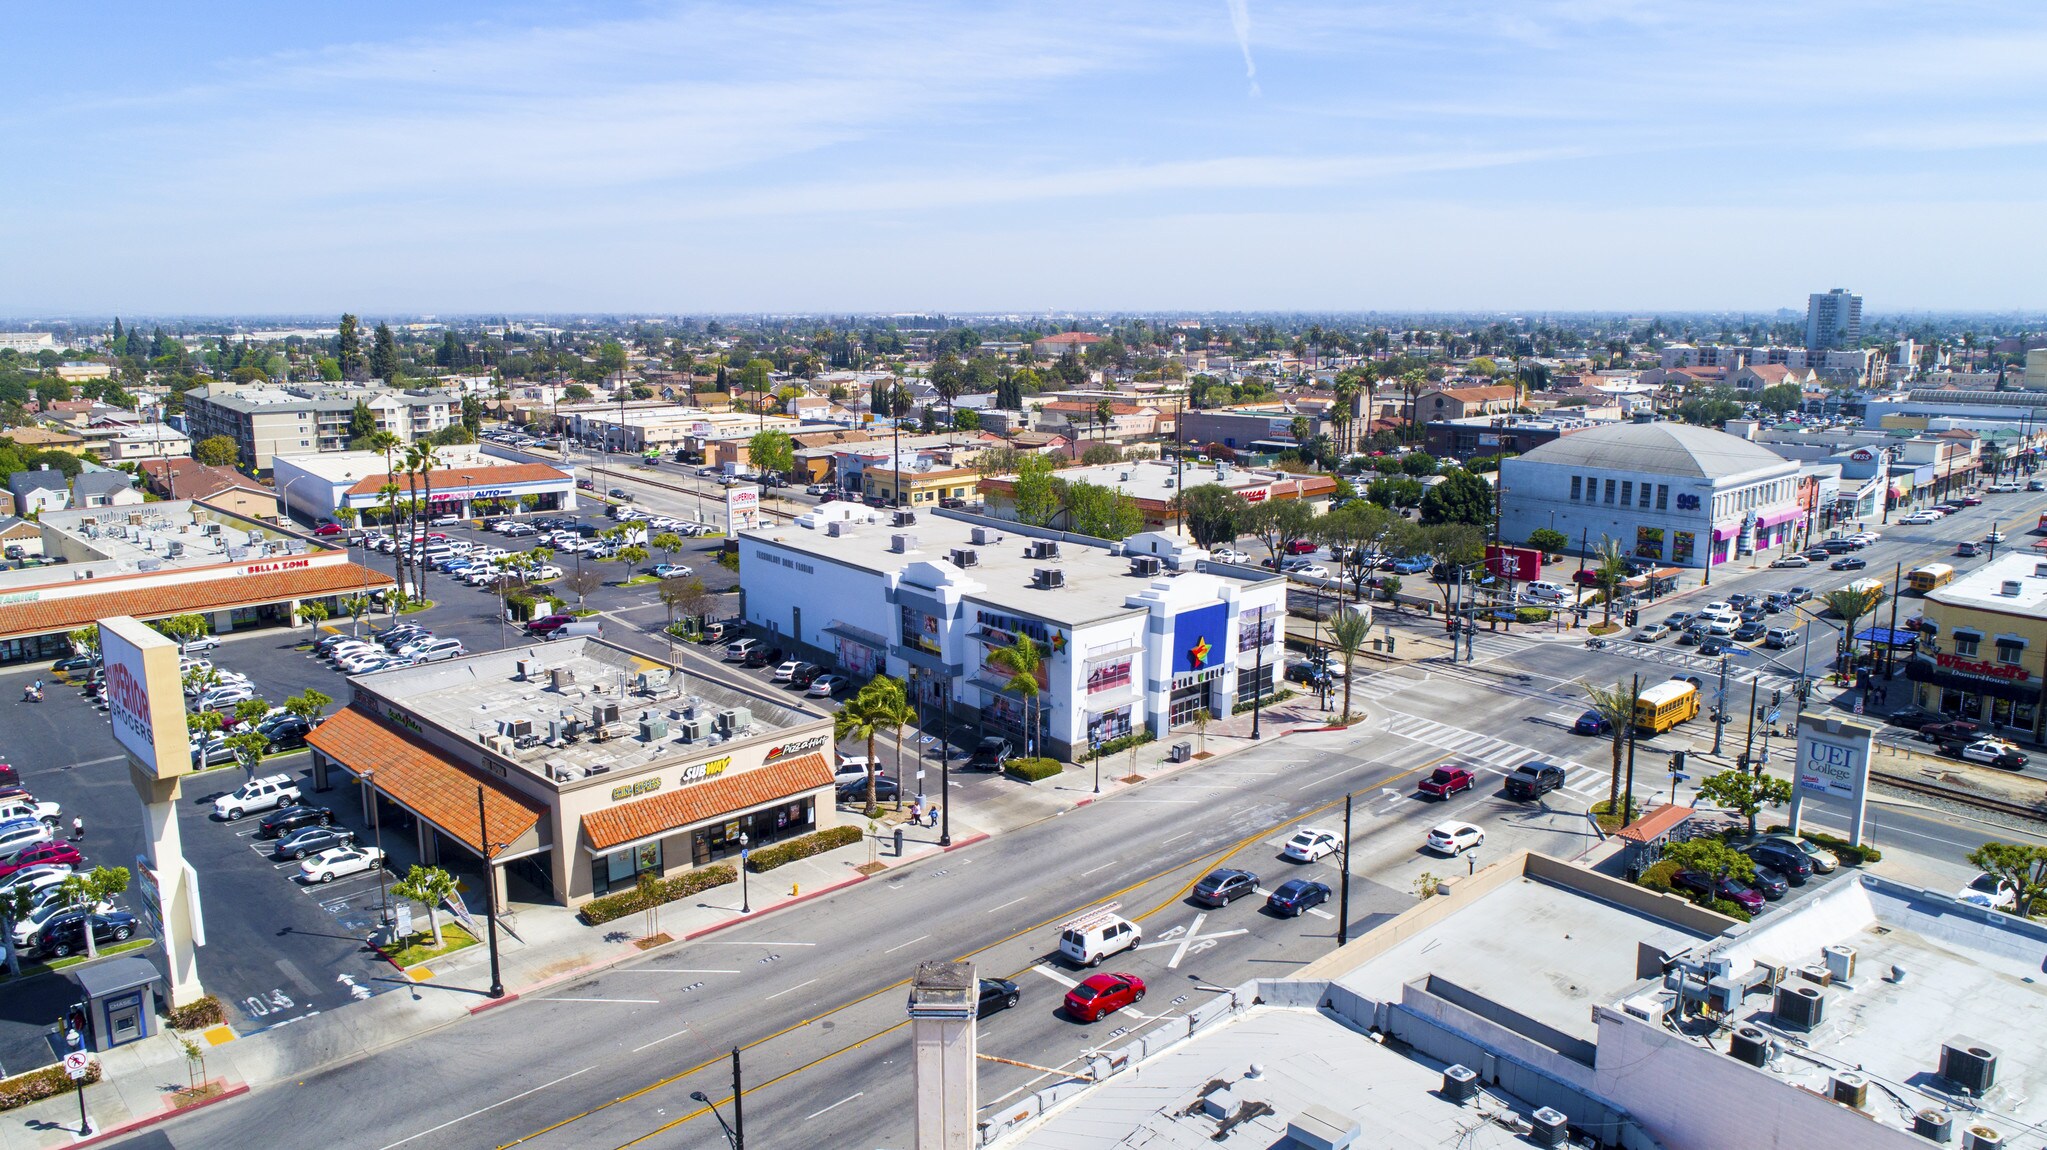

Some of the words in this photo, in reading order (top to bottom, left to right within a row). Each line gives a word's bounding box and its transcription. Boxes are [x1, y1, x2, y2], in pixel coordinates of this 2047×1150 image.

[1852, 453, 1871, 461] WSS
[431, 493, 451, 501] PEP
[475, 489, 501, 498] AUTO
[247, 564, 279, 574] BELLA
[282, 560, 309, 570] ZONE
[976, 610, 1003, 630] STAR
[1936, 653, 2030, 682] Winchell's
[1171, 676, 1193, 691] STAR
[1197, 667, 1225, 683] WORLD
[106, 662, 151, 726] SUPERIOR
[111, 701, 154, 746] GROCERS
[782, 741, 809, 756] Pizza
[808, 735, 829, 749] Hut
[1810, 741, 1853, 769] UEI
[682, 756, 732, 781] SUBWAY
[1808, 760, 1851, 781] College
[611, 785, 634, 800] CHINA
[1158, 925, 1187, 941] R
[1187, 938, 1218, 954] R
